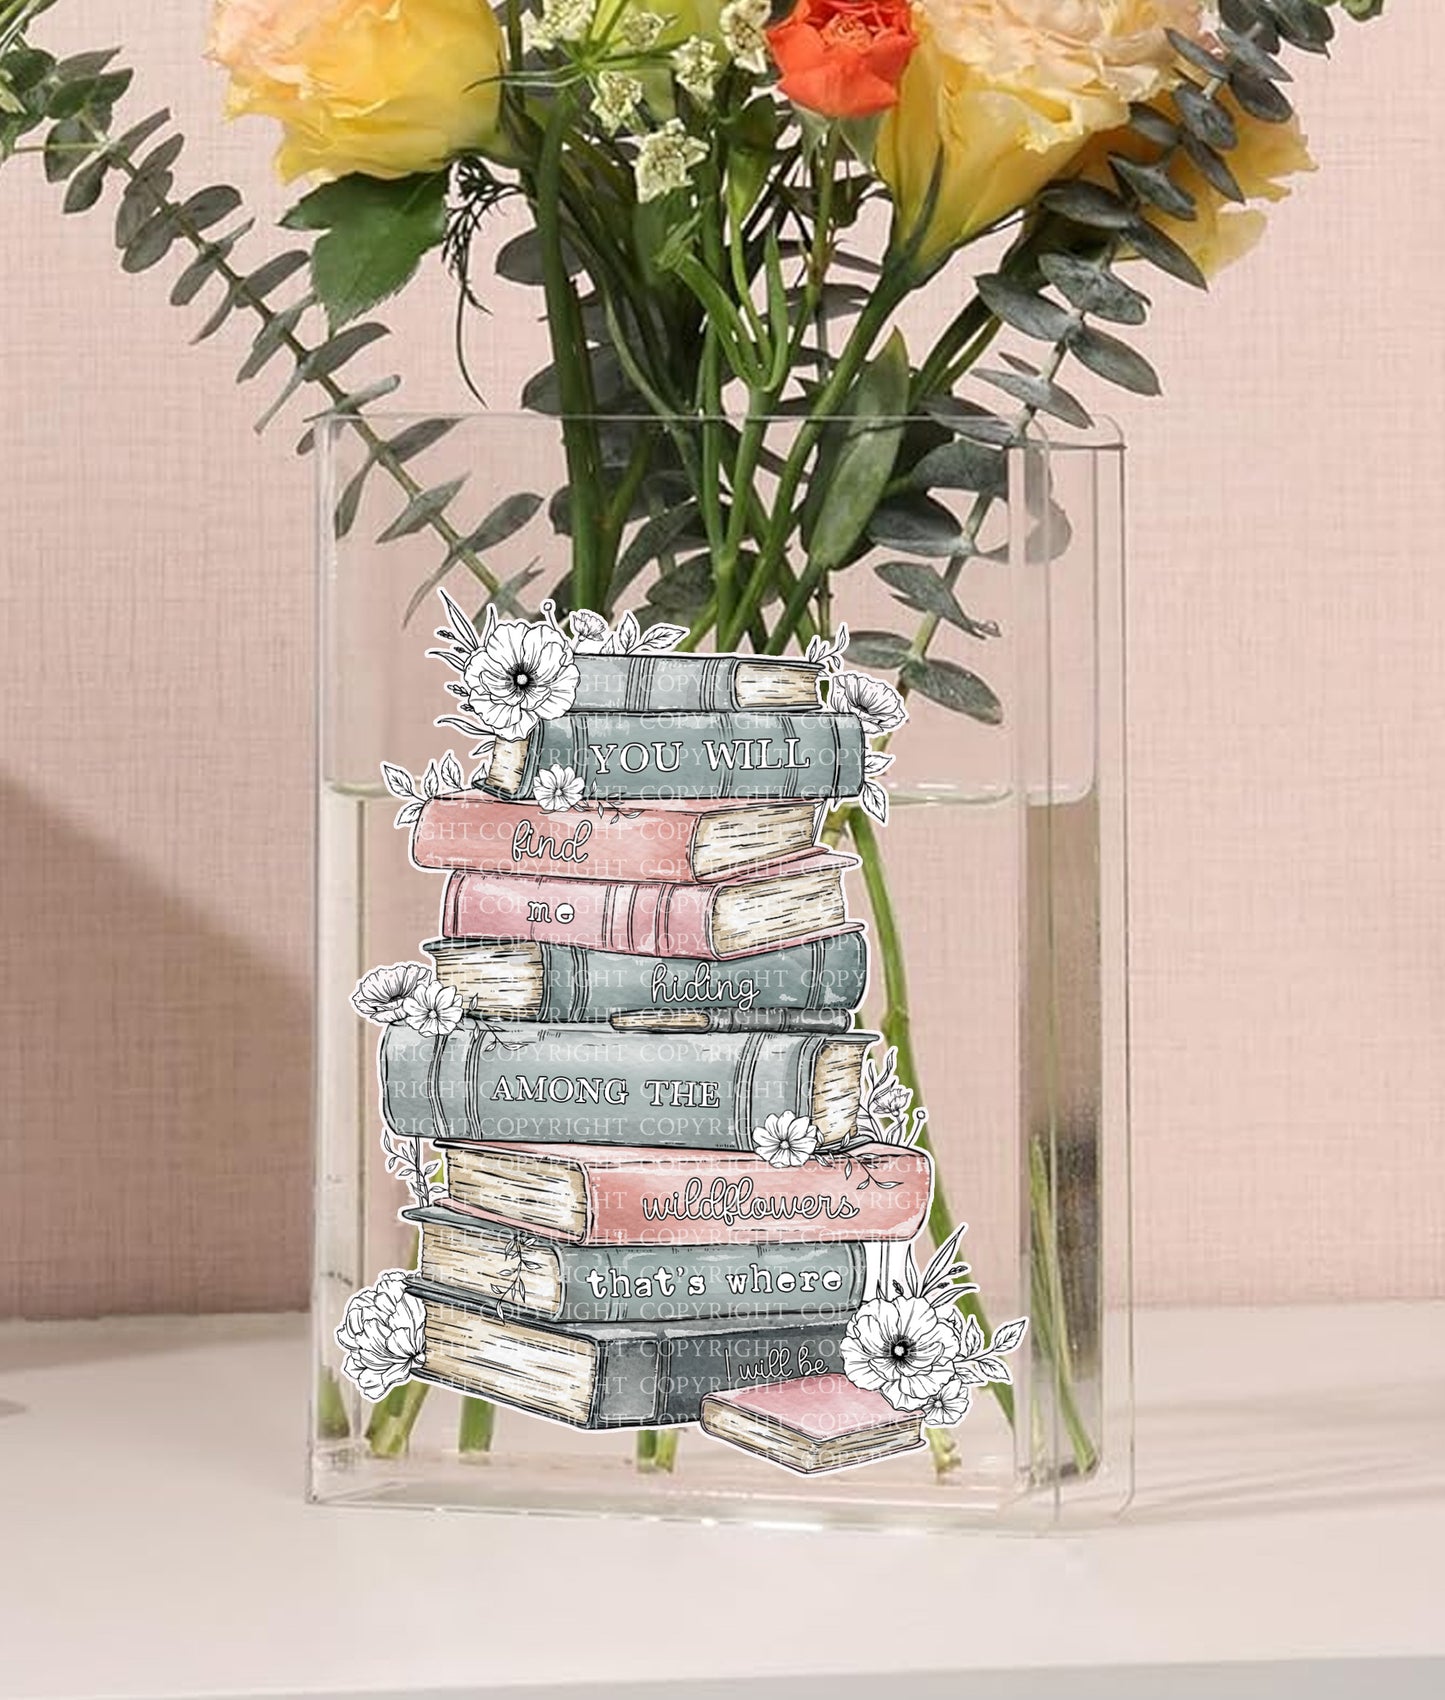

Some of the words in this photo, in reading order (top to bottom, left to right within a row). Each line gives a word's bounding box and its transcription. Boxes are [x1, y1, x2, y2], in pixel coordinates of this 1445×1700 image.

[588, 741, 683, 774] YOU
[703, 738, 810, 771] WILL
[512, 819, 593, 863] find
[527, 901, 575, 925] me
[651, 962, 760, 1010] hiding
[490, 1075, 630, 1105] AMONG
[645, 1080, 721, 1109] THE
[642, 1176, 860, 1226] wildflowers
[586, 1266, 706, 1299] that's
[726, 1263, 843, 1295] where
[738, 1347, 793, 1382] will
[797, 1346, 831, 1377] be
